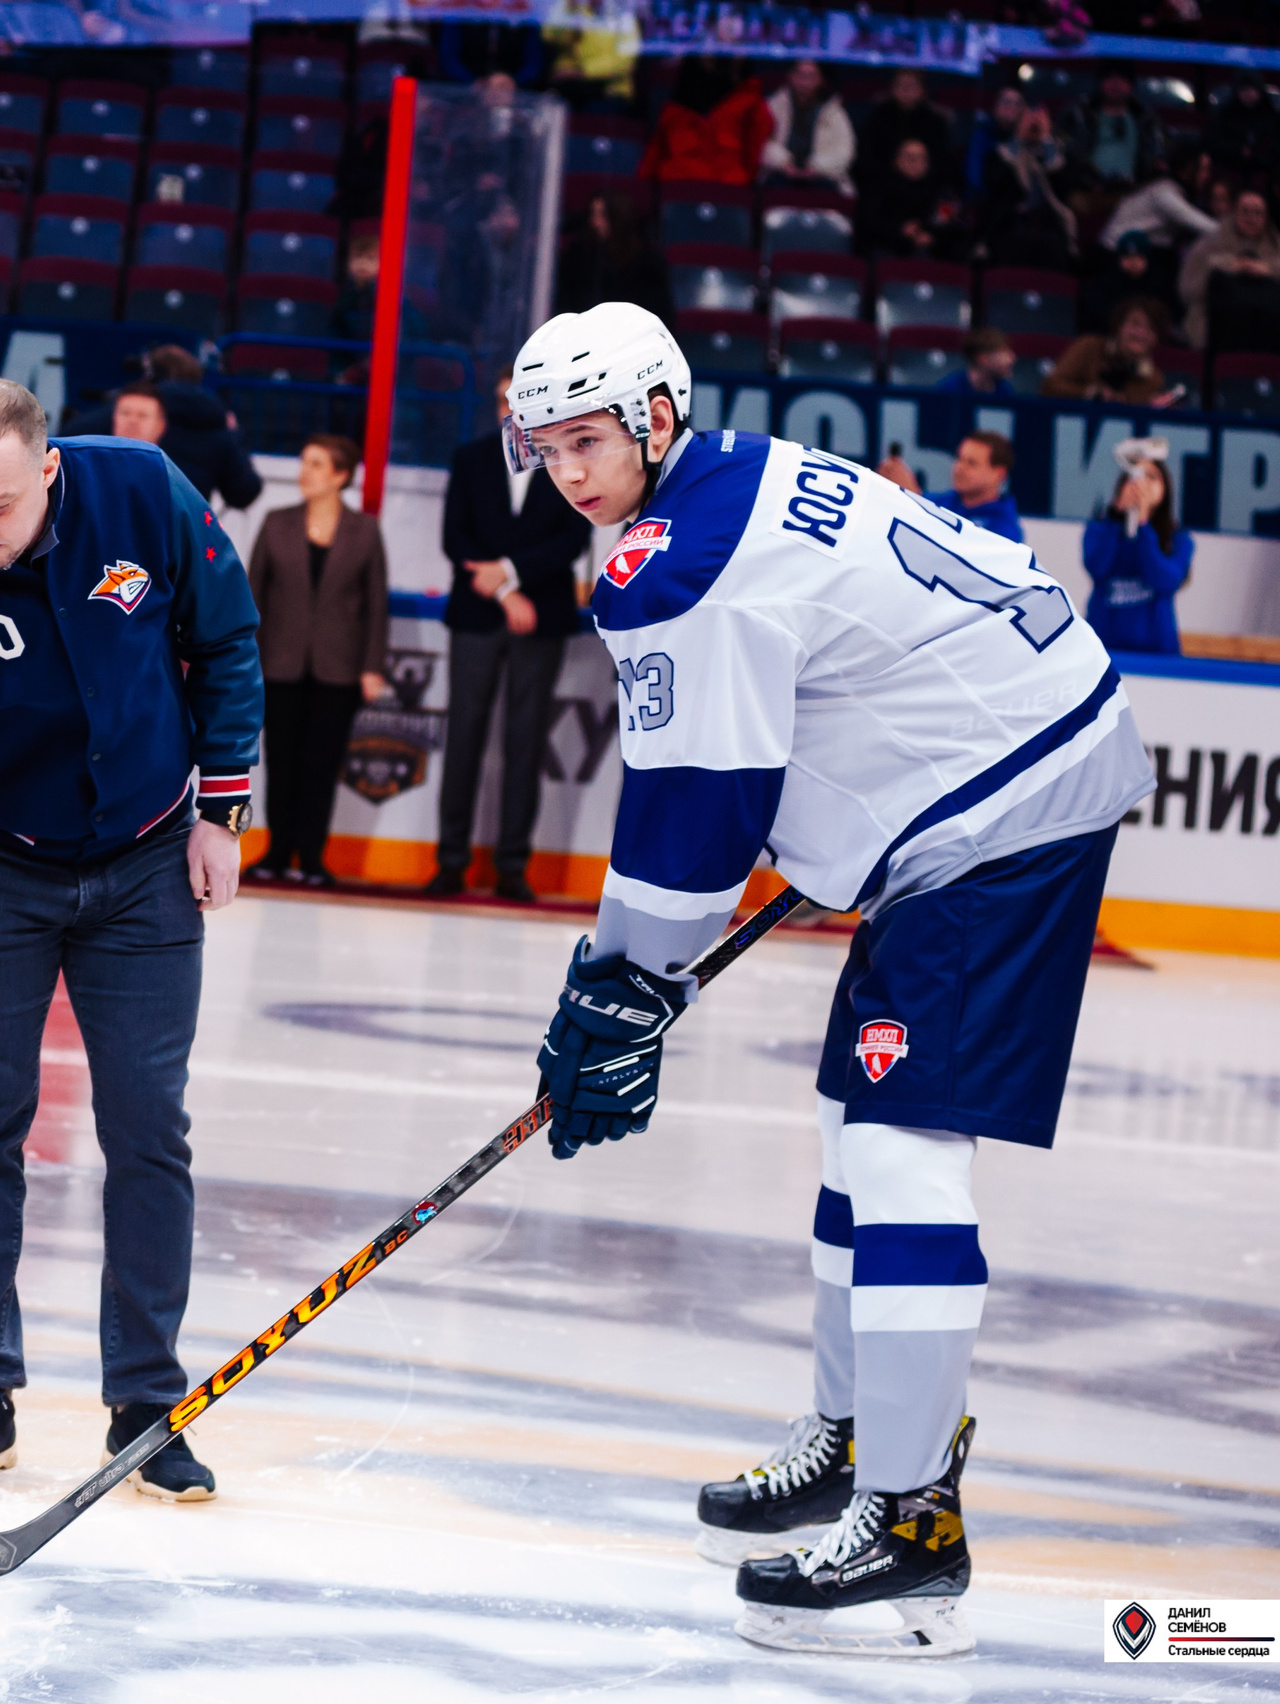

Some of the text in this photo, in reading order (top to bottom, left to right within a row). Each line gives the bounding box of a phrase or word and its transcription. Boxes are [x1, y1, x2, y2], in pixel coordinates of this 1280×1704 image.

[636, 359, 664, 380] CCM
[517, 385, 549, 400] CCM
[781, 446, 859, 549] ЮСУ
[886, 487, 1075, 654] 1
[383, 1229, 408, 1256] BC
[168, 1241, 377, 1433] SOYUZ
[842, 1554, 894, 1583] BAUER
